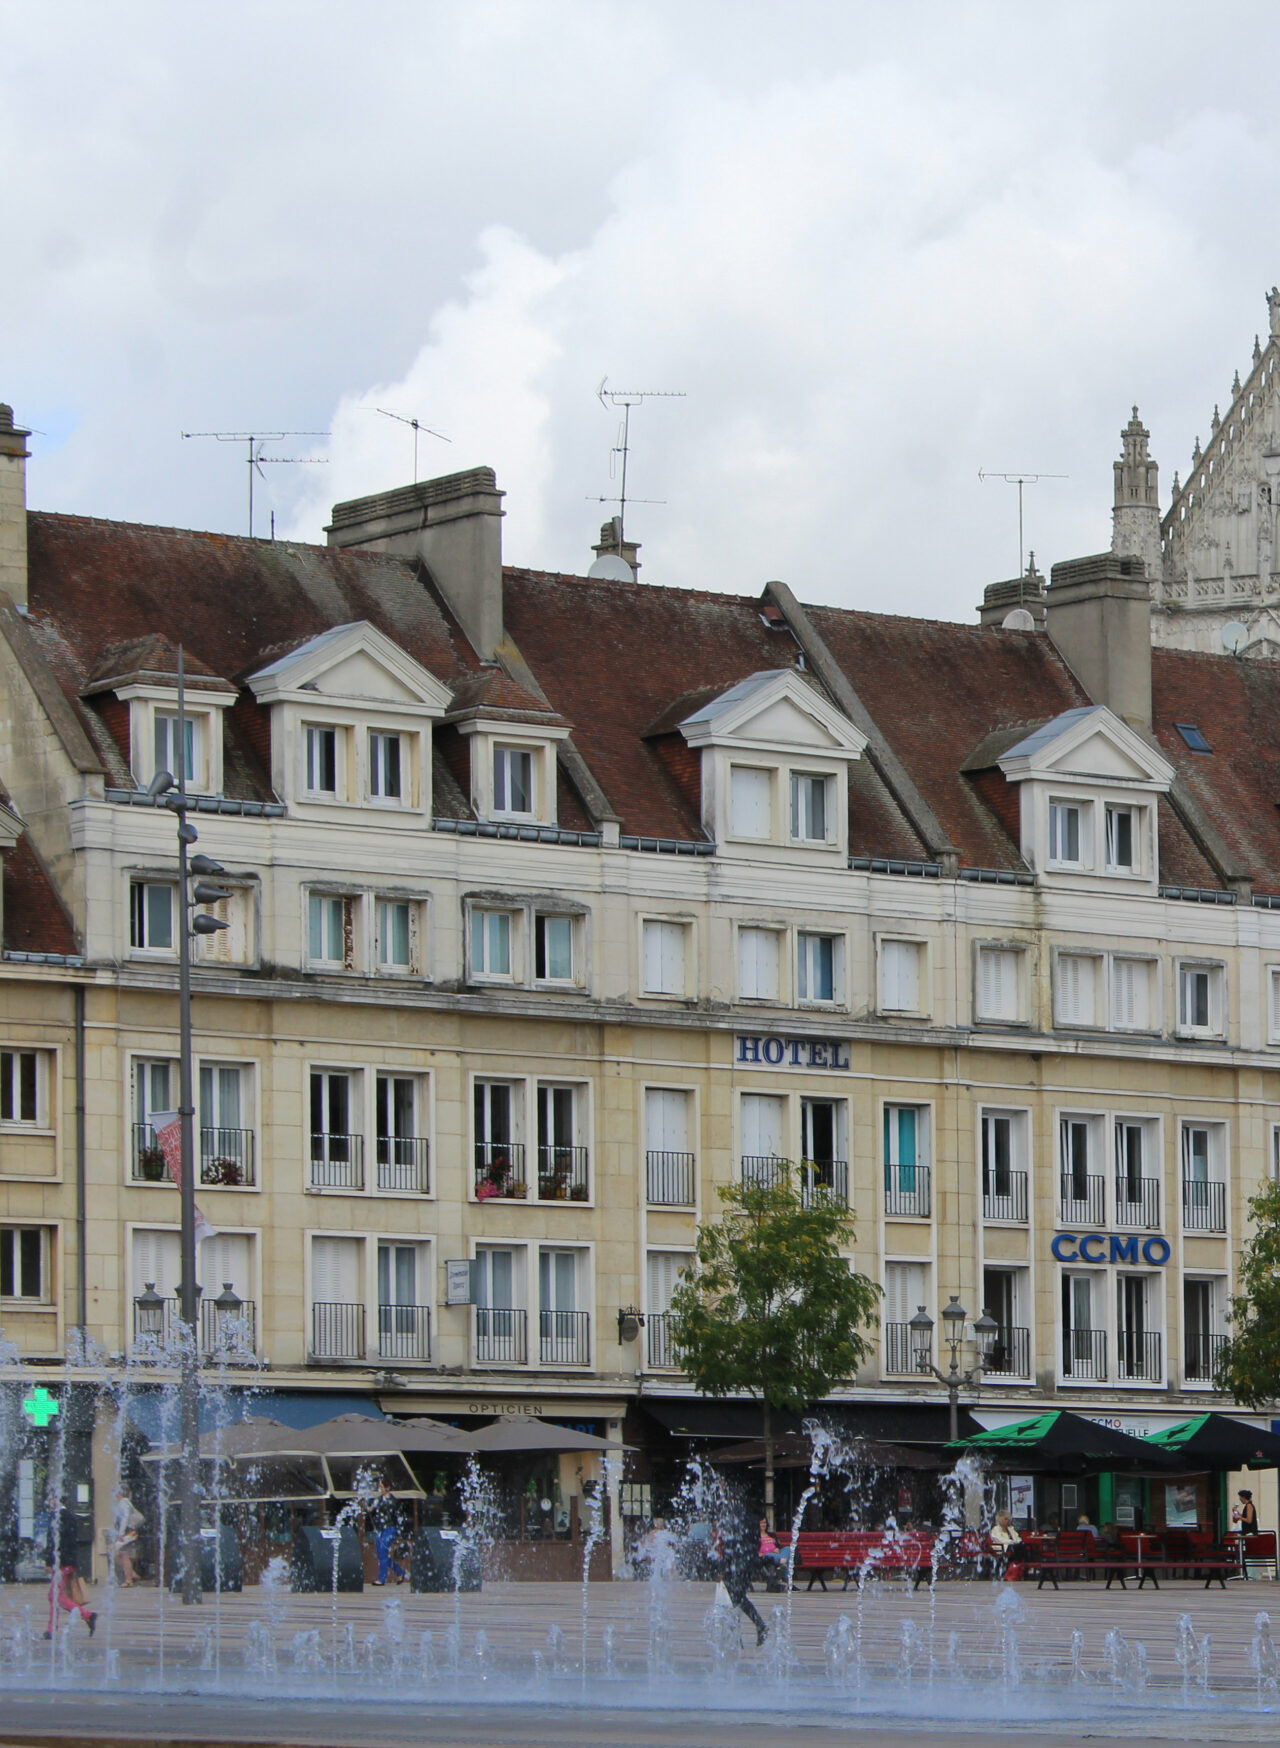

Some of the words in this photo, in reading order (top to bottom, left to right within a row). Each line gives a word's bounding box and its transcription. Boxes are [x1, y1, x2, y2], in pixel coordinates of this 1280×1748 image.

[737, 1036, 849, 1068] HOTEL
[1051, 1233, 1171, 1265] CCMO
[469, 1404, 543, 1415] OPTICIEN
